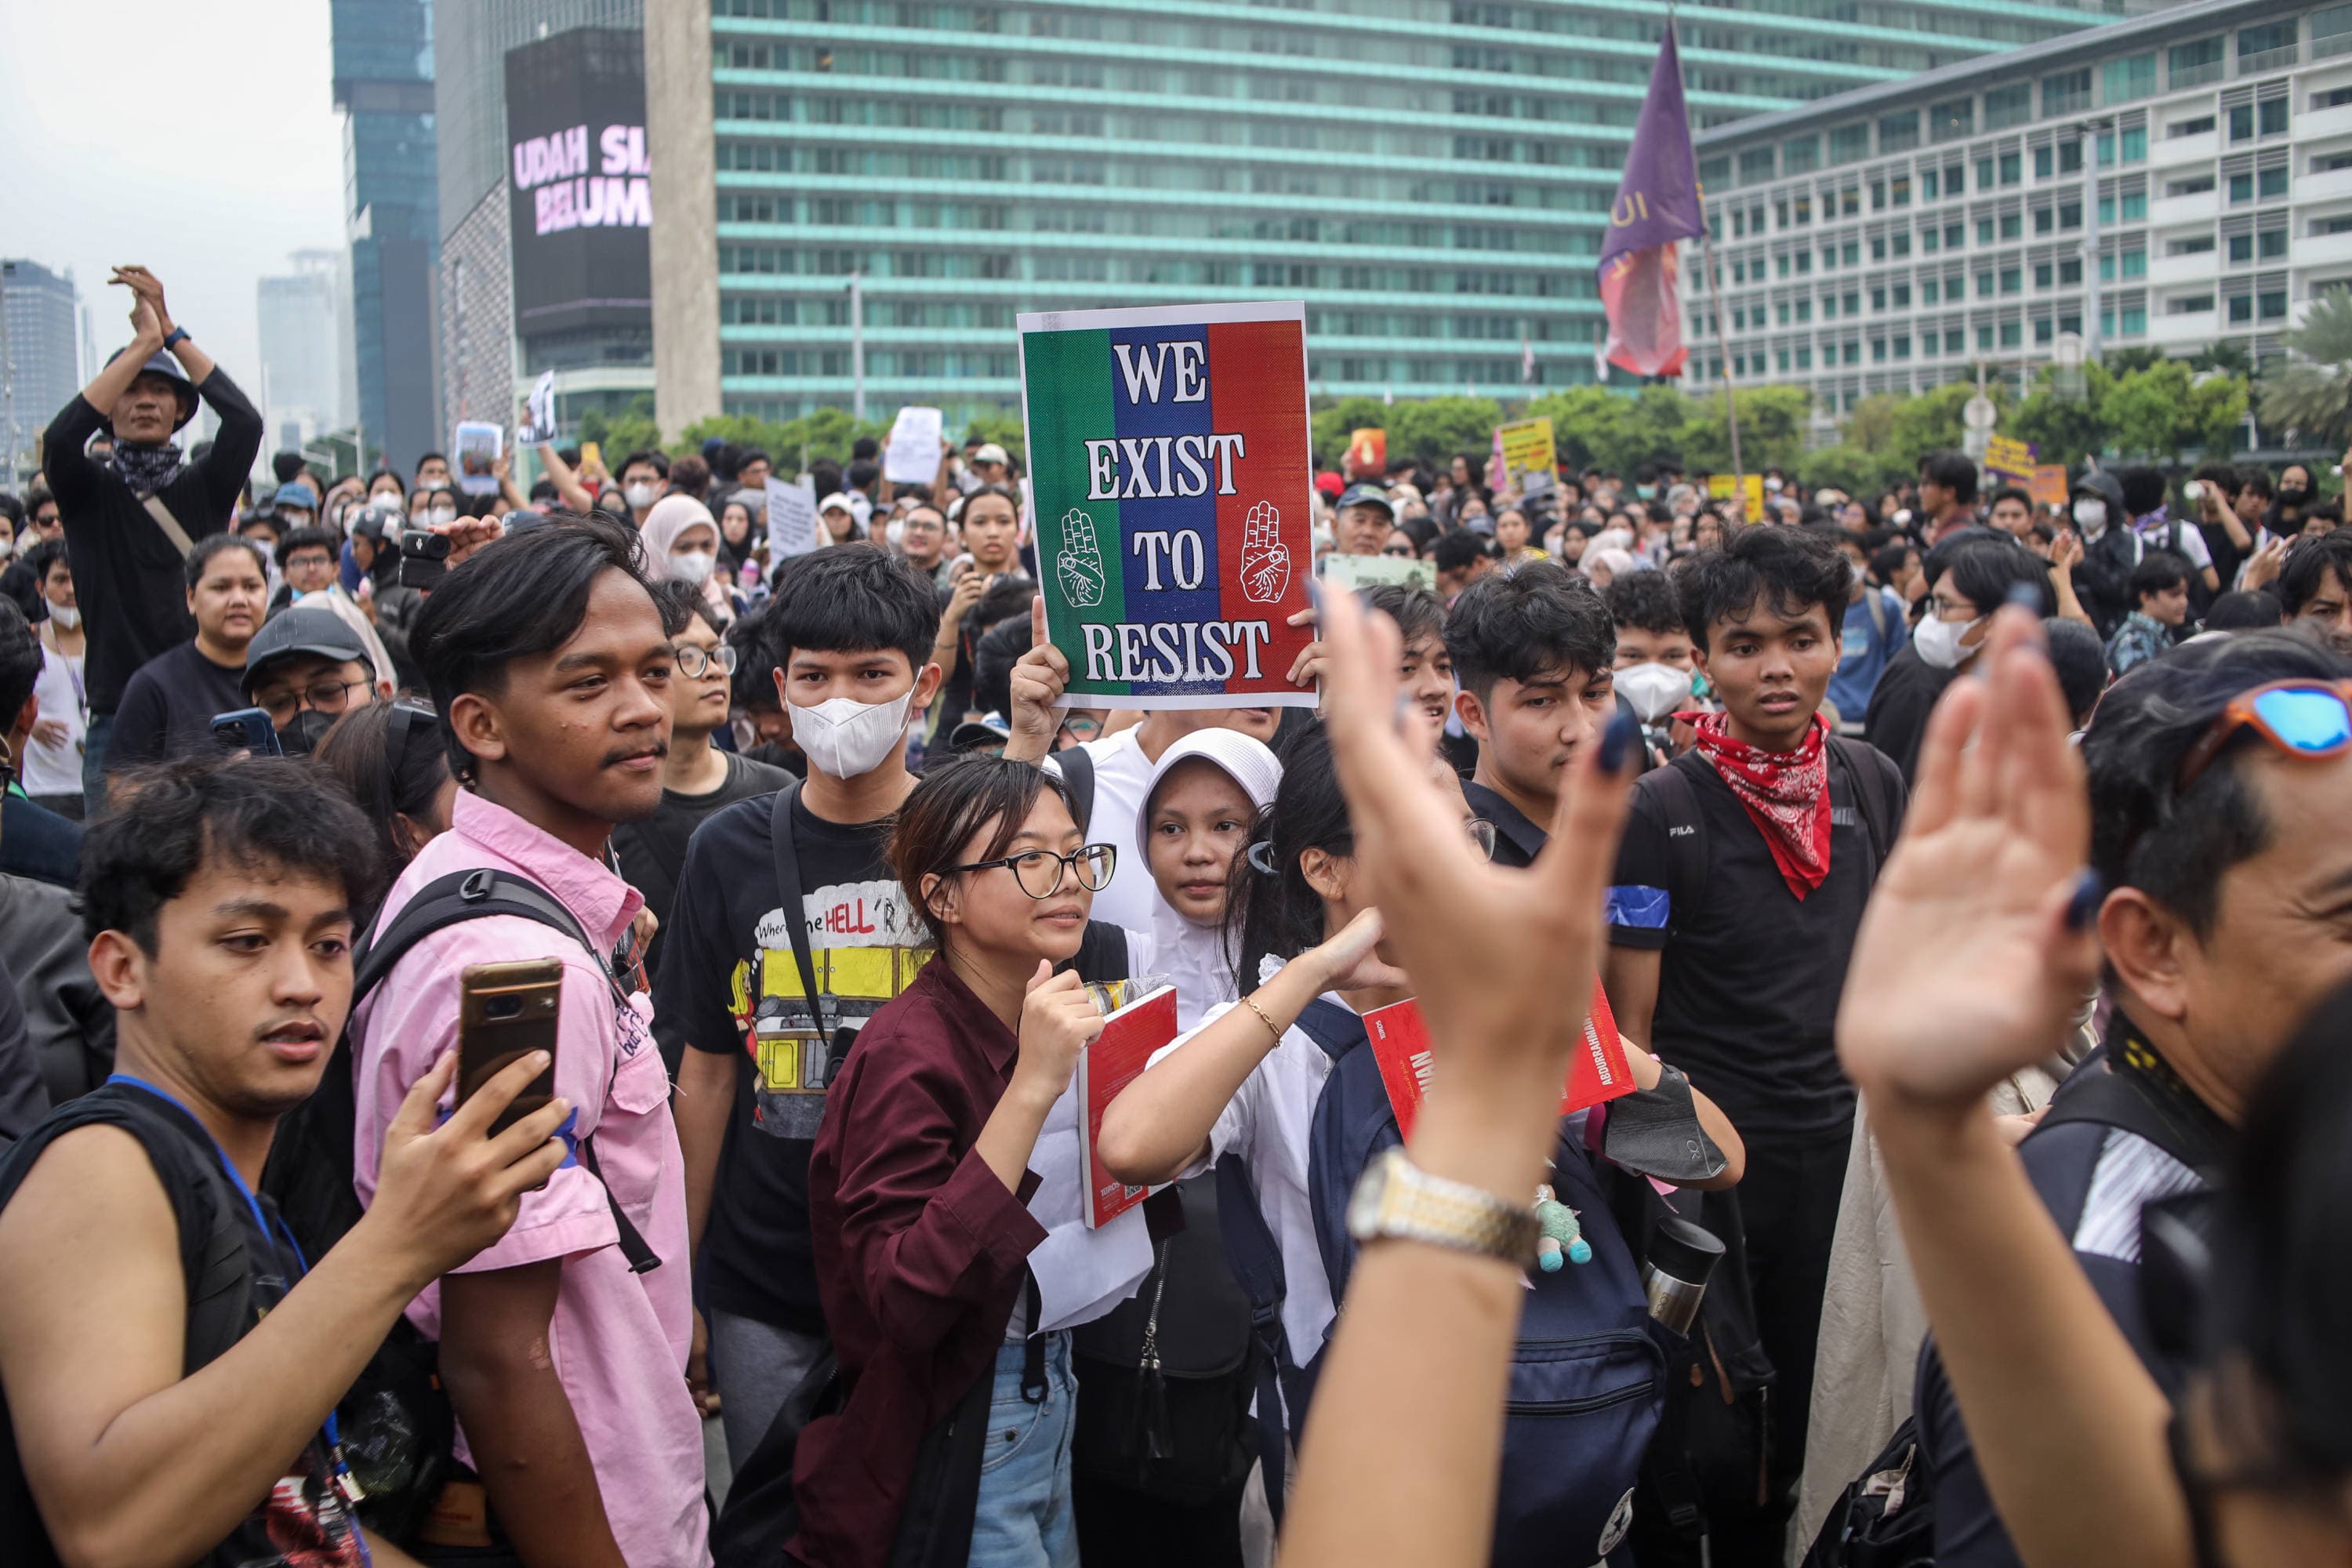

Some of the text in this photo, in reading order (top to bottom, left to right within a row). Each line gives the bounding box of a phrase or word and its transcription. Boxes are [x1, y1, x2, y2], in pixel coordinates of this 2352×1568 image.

[514, 124, 652, 191] UDAH SI
[535, 176, 653, 236] BELUM
[1113, 340, 1206, 404] WE
[1084, 434, 1245, 500] EXIST
[1134, 529, 1204, 591] TO
[1080, 619, 1270, 683] RESIST
[1669, 825, 1695, 837] FILA
[759, 922, 788, 938] Wher
[826, 898, 874, 933] HELL
[1582, 1017, 1613, 1086] ABDURRAHMAN
